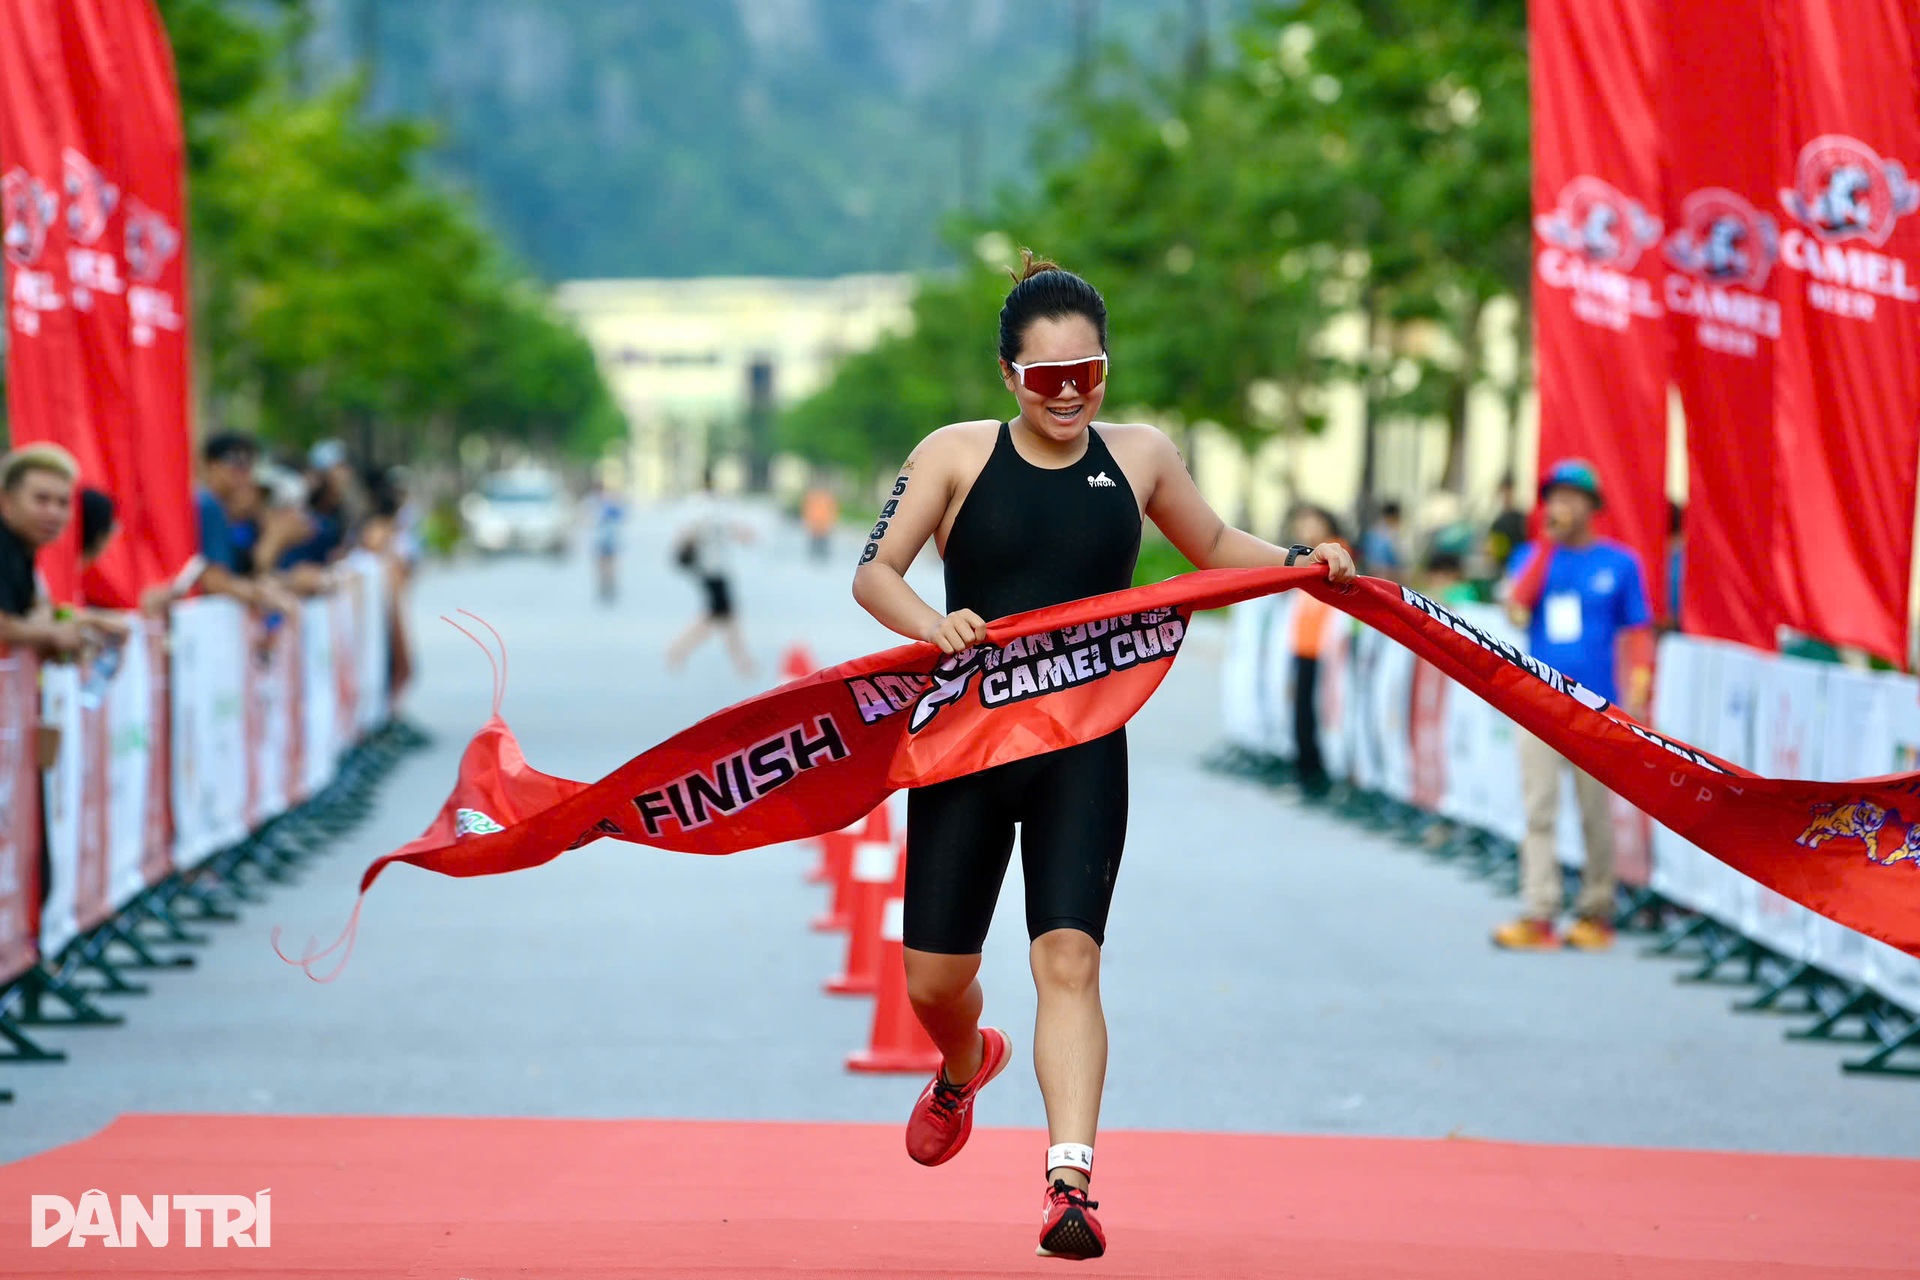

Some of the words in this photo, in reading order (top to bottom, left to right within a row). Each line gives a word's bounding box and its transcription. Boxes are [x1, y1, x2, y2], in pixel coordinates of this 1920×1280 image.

[1780, 229, 1920, 301] CAMEL
[858, 476, 909, 566] 5439
[982, 643, 1106, 704] CAMEL
[1110, 620, 1184, 667] CUP
[633, 713, 851, 837] FINISH
